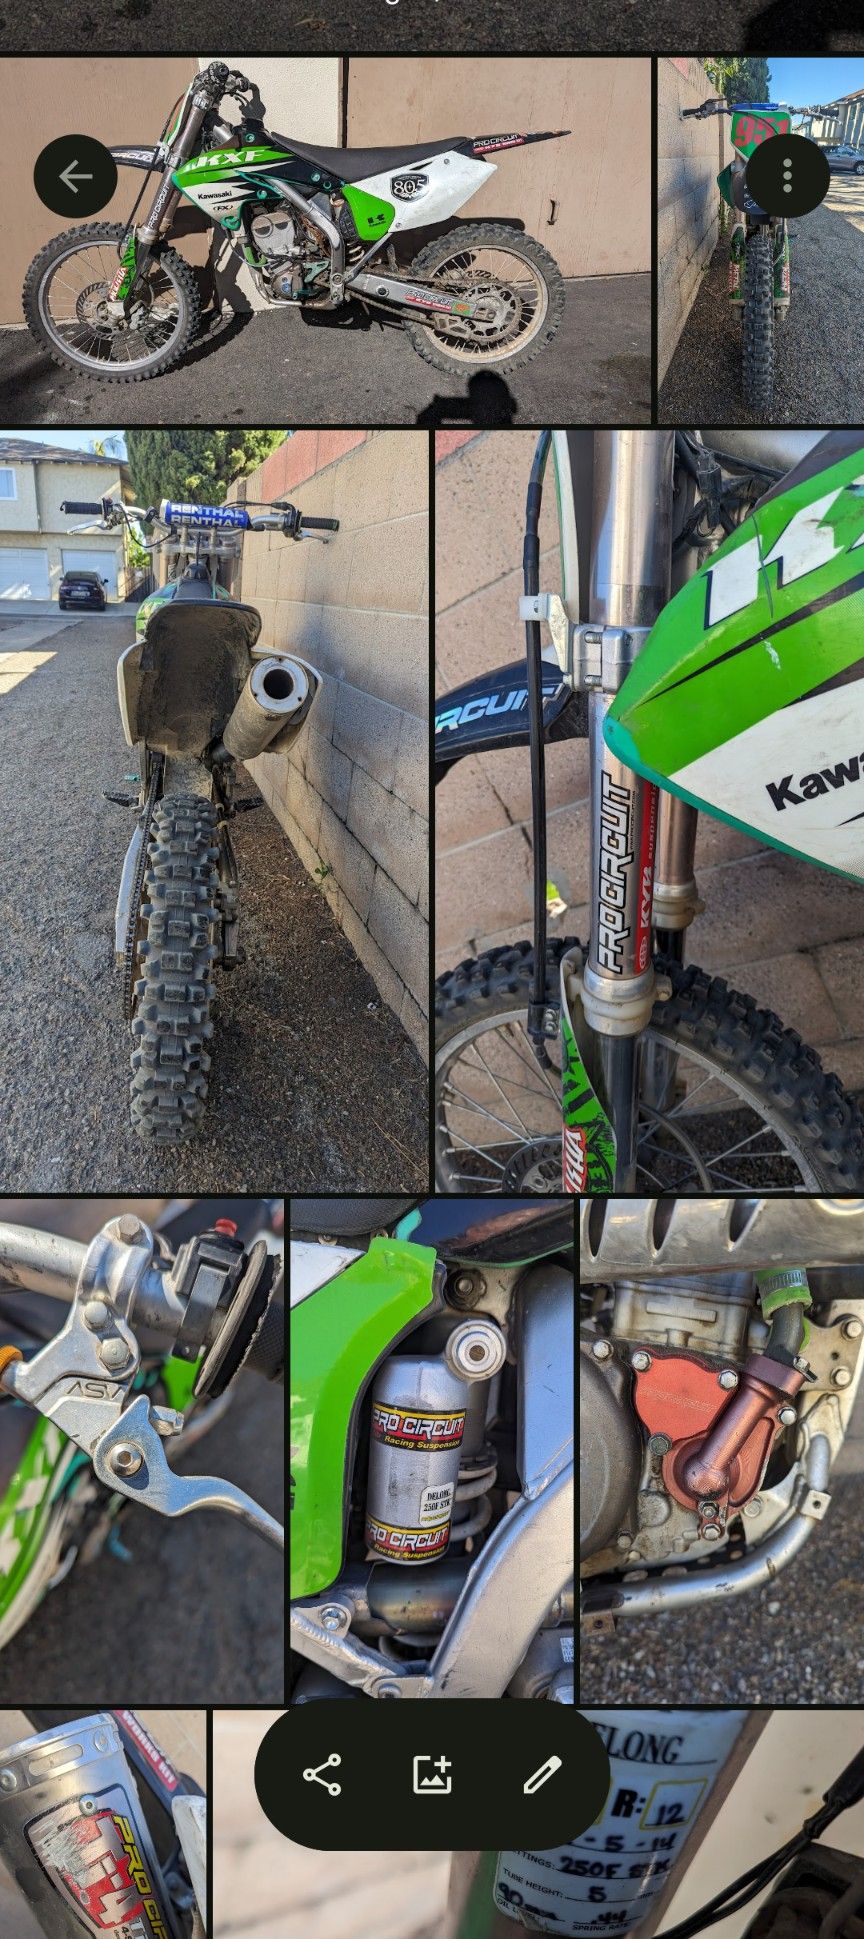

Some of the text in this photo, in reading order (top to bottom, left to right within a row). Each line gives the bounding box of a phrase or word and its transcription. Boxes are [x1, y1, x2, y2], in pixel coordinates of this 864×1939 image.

[194, 149, 266, 169] KXF
[198, 191, 232, 199] Kawasaki
[393, 179, 428, 195] 805
[171, 504, 243, 518] RENTHAL
[171, 514, 241, 527] RENTHAL
[765, 751, 864, 811] Kaw
[597, 769, 635, 975] PRO CIRCUIT
[66, 1381, 122, 1399] ASV
[372, 1408, 464, 1440] PRO CIRCUIT
[384, 1435, 415, 1448] Racing
[389, 1526, 448, 1551] CIRCUIT
[611, 1788, 646, 1818] R:
[654, 1802, 686, 1827] 12
[111, 1814, 152, 1896] PRO
[559, 1856, 622, 1879] 250F
[572, 1923, 607, 1932] SPRING
